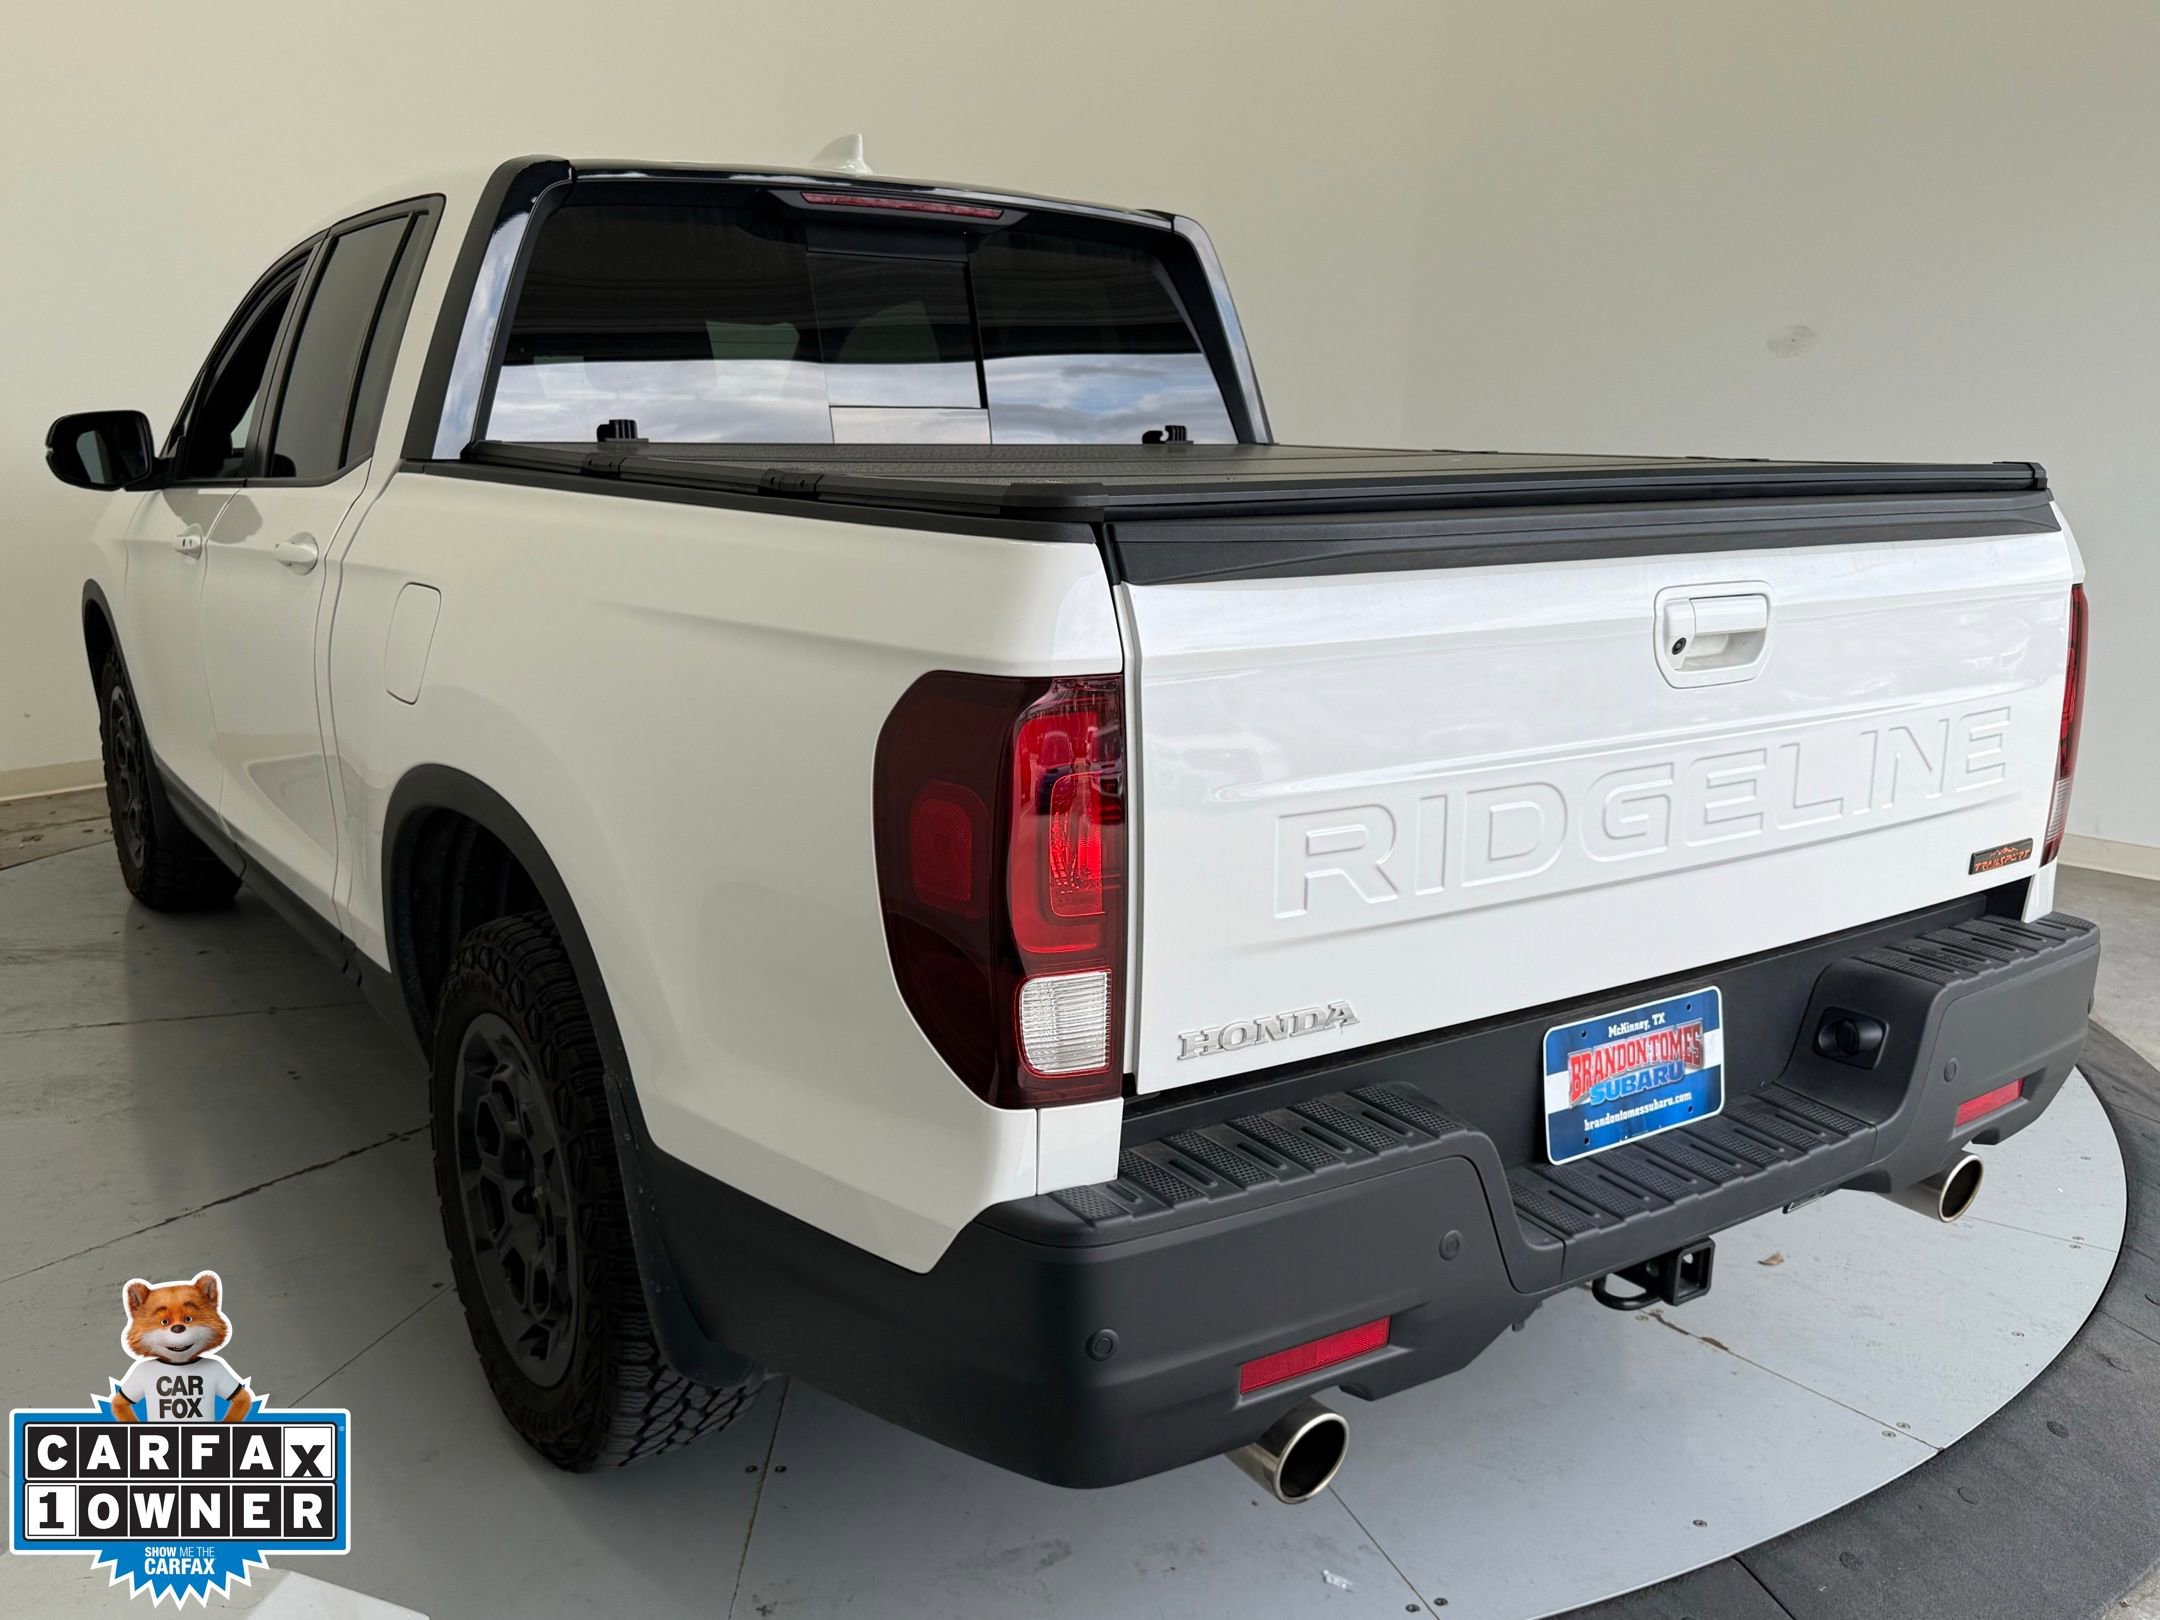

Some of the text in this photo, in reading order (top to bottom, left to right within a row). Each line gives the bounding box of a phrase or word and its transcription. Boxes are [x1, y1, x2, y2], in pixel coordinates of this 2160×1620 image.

[1274, 706, 2011, 919] RIDGELINE
[1973, 849, 2031, 872] TRAILSPORT
[1177, 999, 1360, 1061] HONDA
[1608, 1012, 1666, 1038] McKinney, TX
[1569, 1023, 1703, 1101] BRANDON TOMES
[1590, 1062, 1686, 1106] SUBARU
[1584, 1091, 1692, 1131] brandontomessubaru.com
